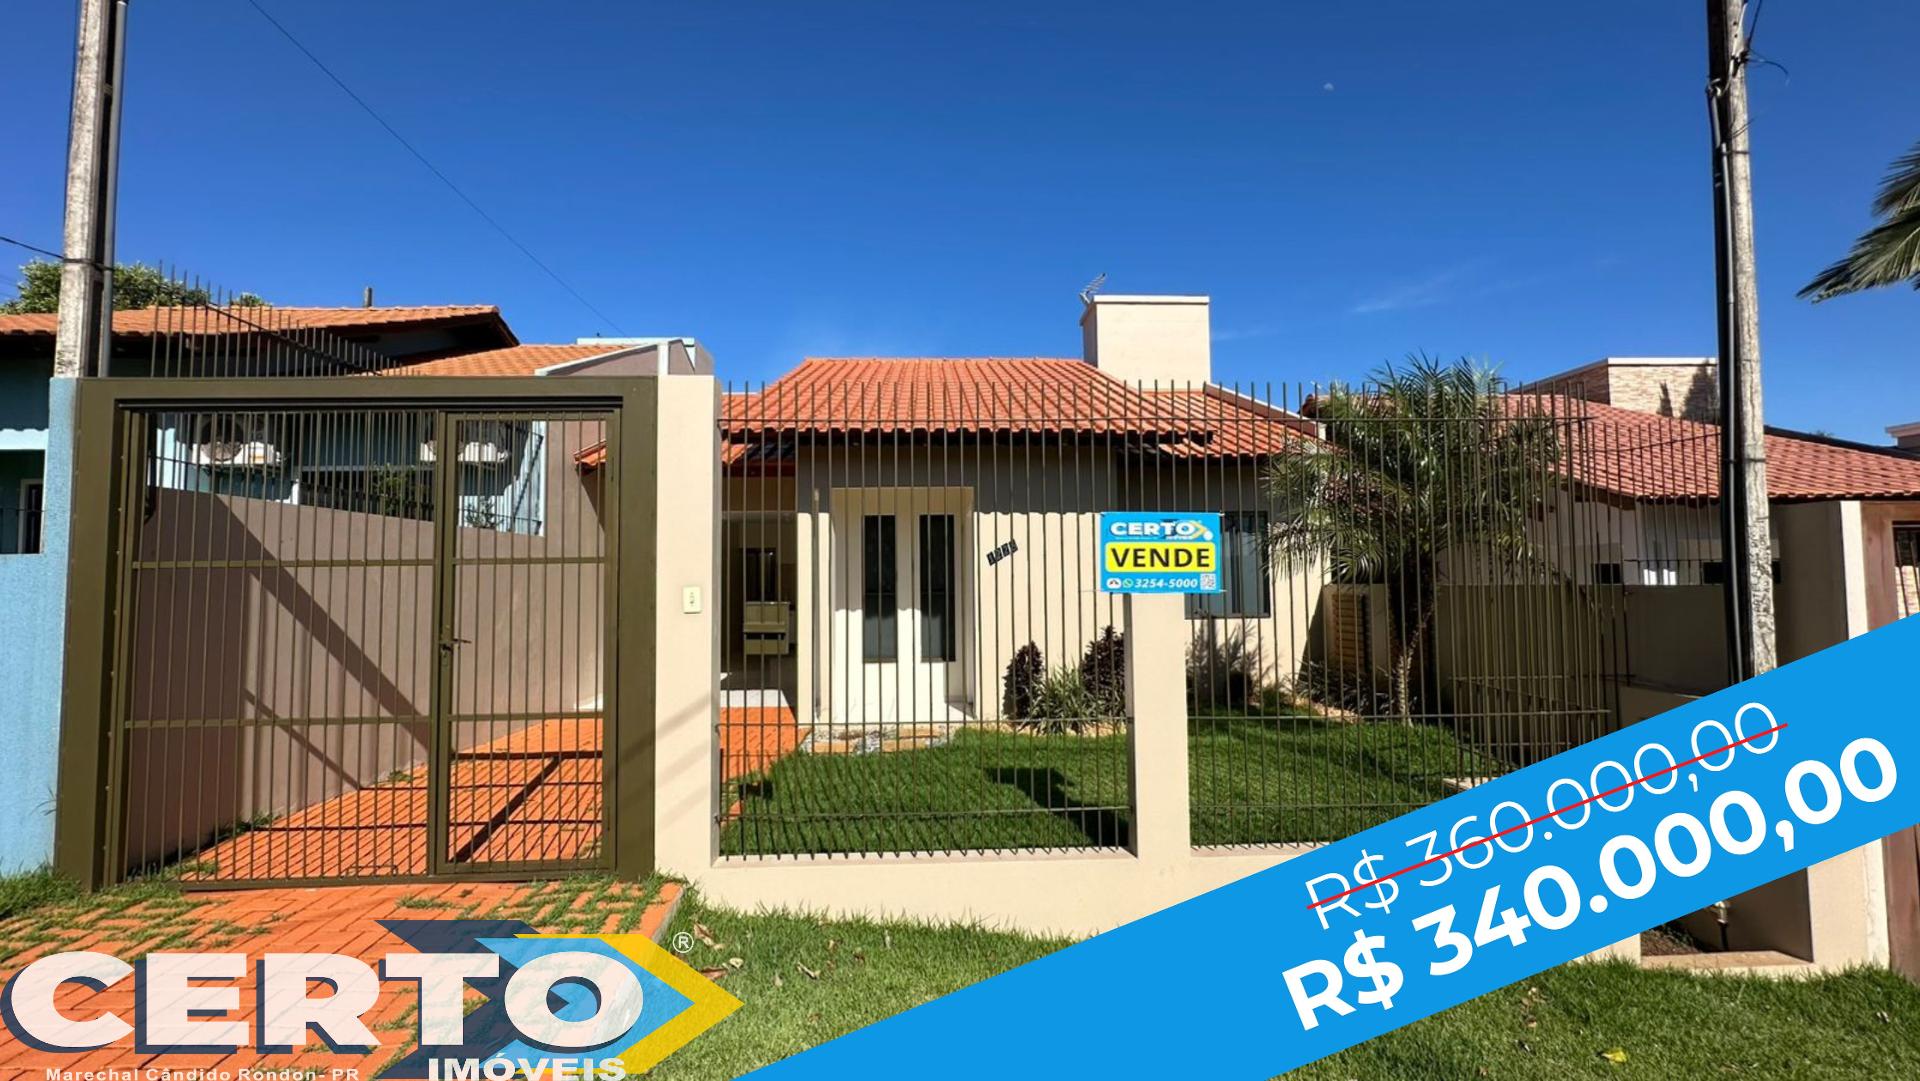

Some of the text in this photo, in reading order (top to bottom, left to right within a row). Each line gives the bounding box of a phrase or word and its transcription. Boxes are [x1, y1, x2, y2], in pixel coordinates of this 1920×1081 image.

[1110, 521, 1196, 536] CERTO
[1111, 548, 1210, 568] VENDE
[1134, 578, 1198, 589] 3254-5000
